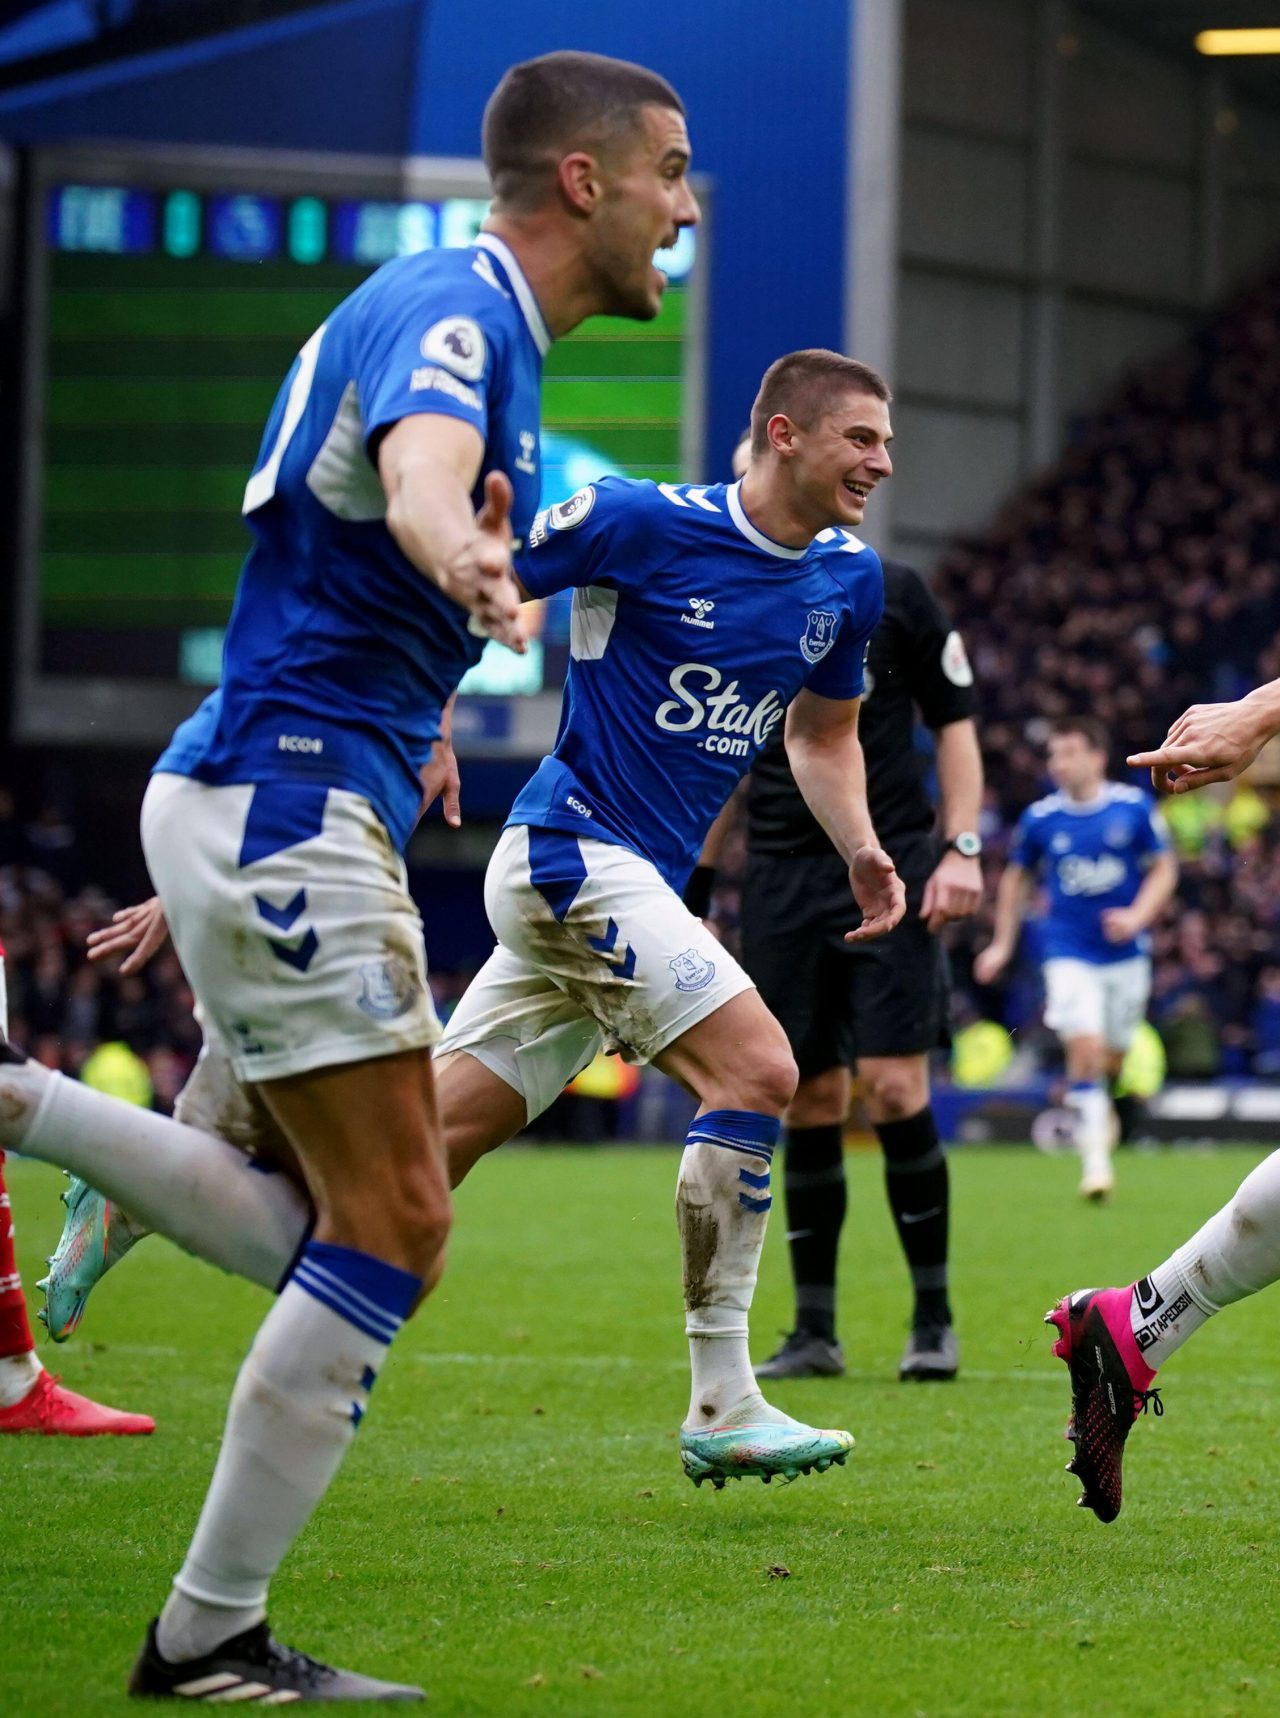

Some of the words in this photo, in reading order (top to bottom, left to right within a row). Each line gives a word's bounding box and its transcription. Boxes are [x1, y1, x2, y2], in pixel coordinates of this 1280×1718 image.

[680, 614, 715, 630] hummel
[655, 663, 784, 745] Stake
[696, 735, 750, 757] .com
[1150, 1290, 1194, 1336] TAPEDESI
